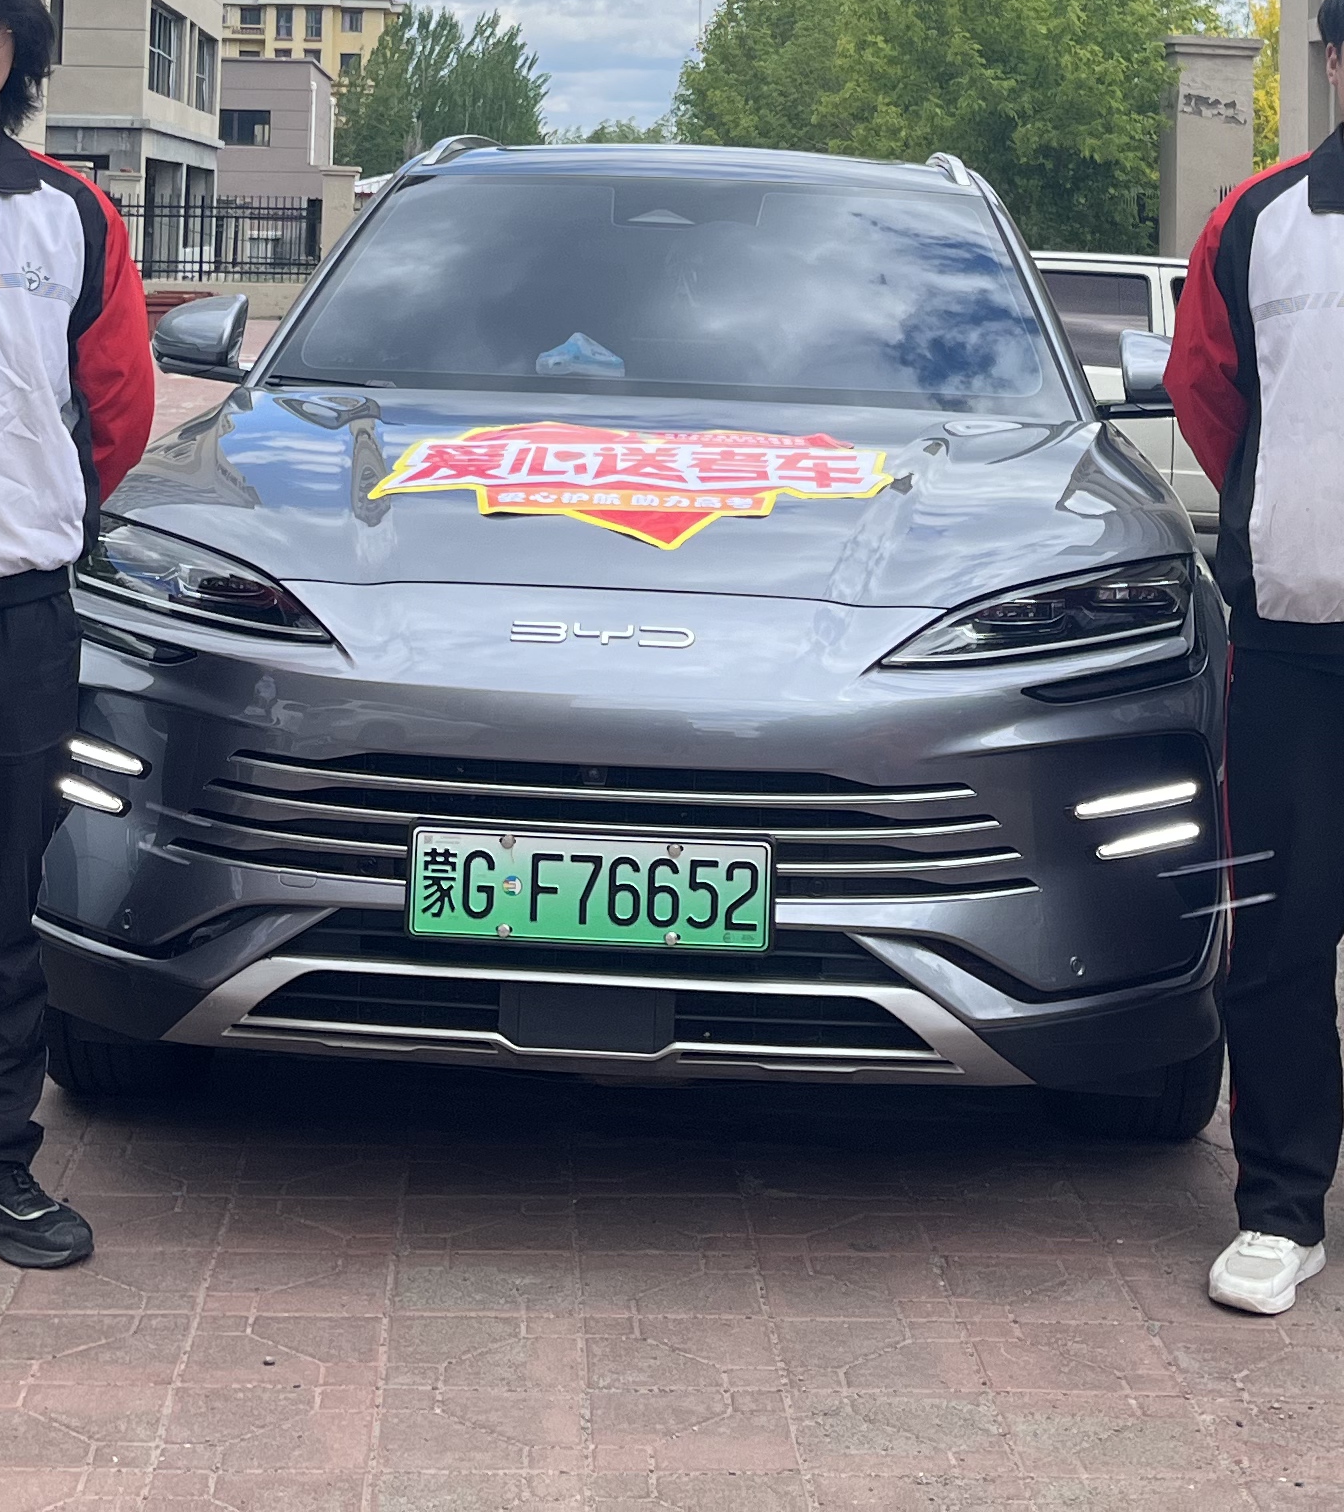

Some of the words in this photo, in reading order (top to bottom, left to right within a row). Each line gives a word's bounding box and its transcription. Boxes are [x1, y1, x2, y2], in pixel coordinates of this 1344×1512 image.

[401, 442, 864, 489] 爱心送考车
[497, 491, 621, 506] 爱心护航
[631, 494, 754, 509] 助力高考
[510, 620, 696, 649] BYD
